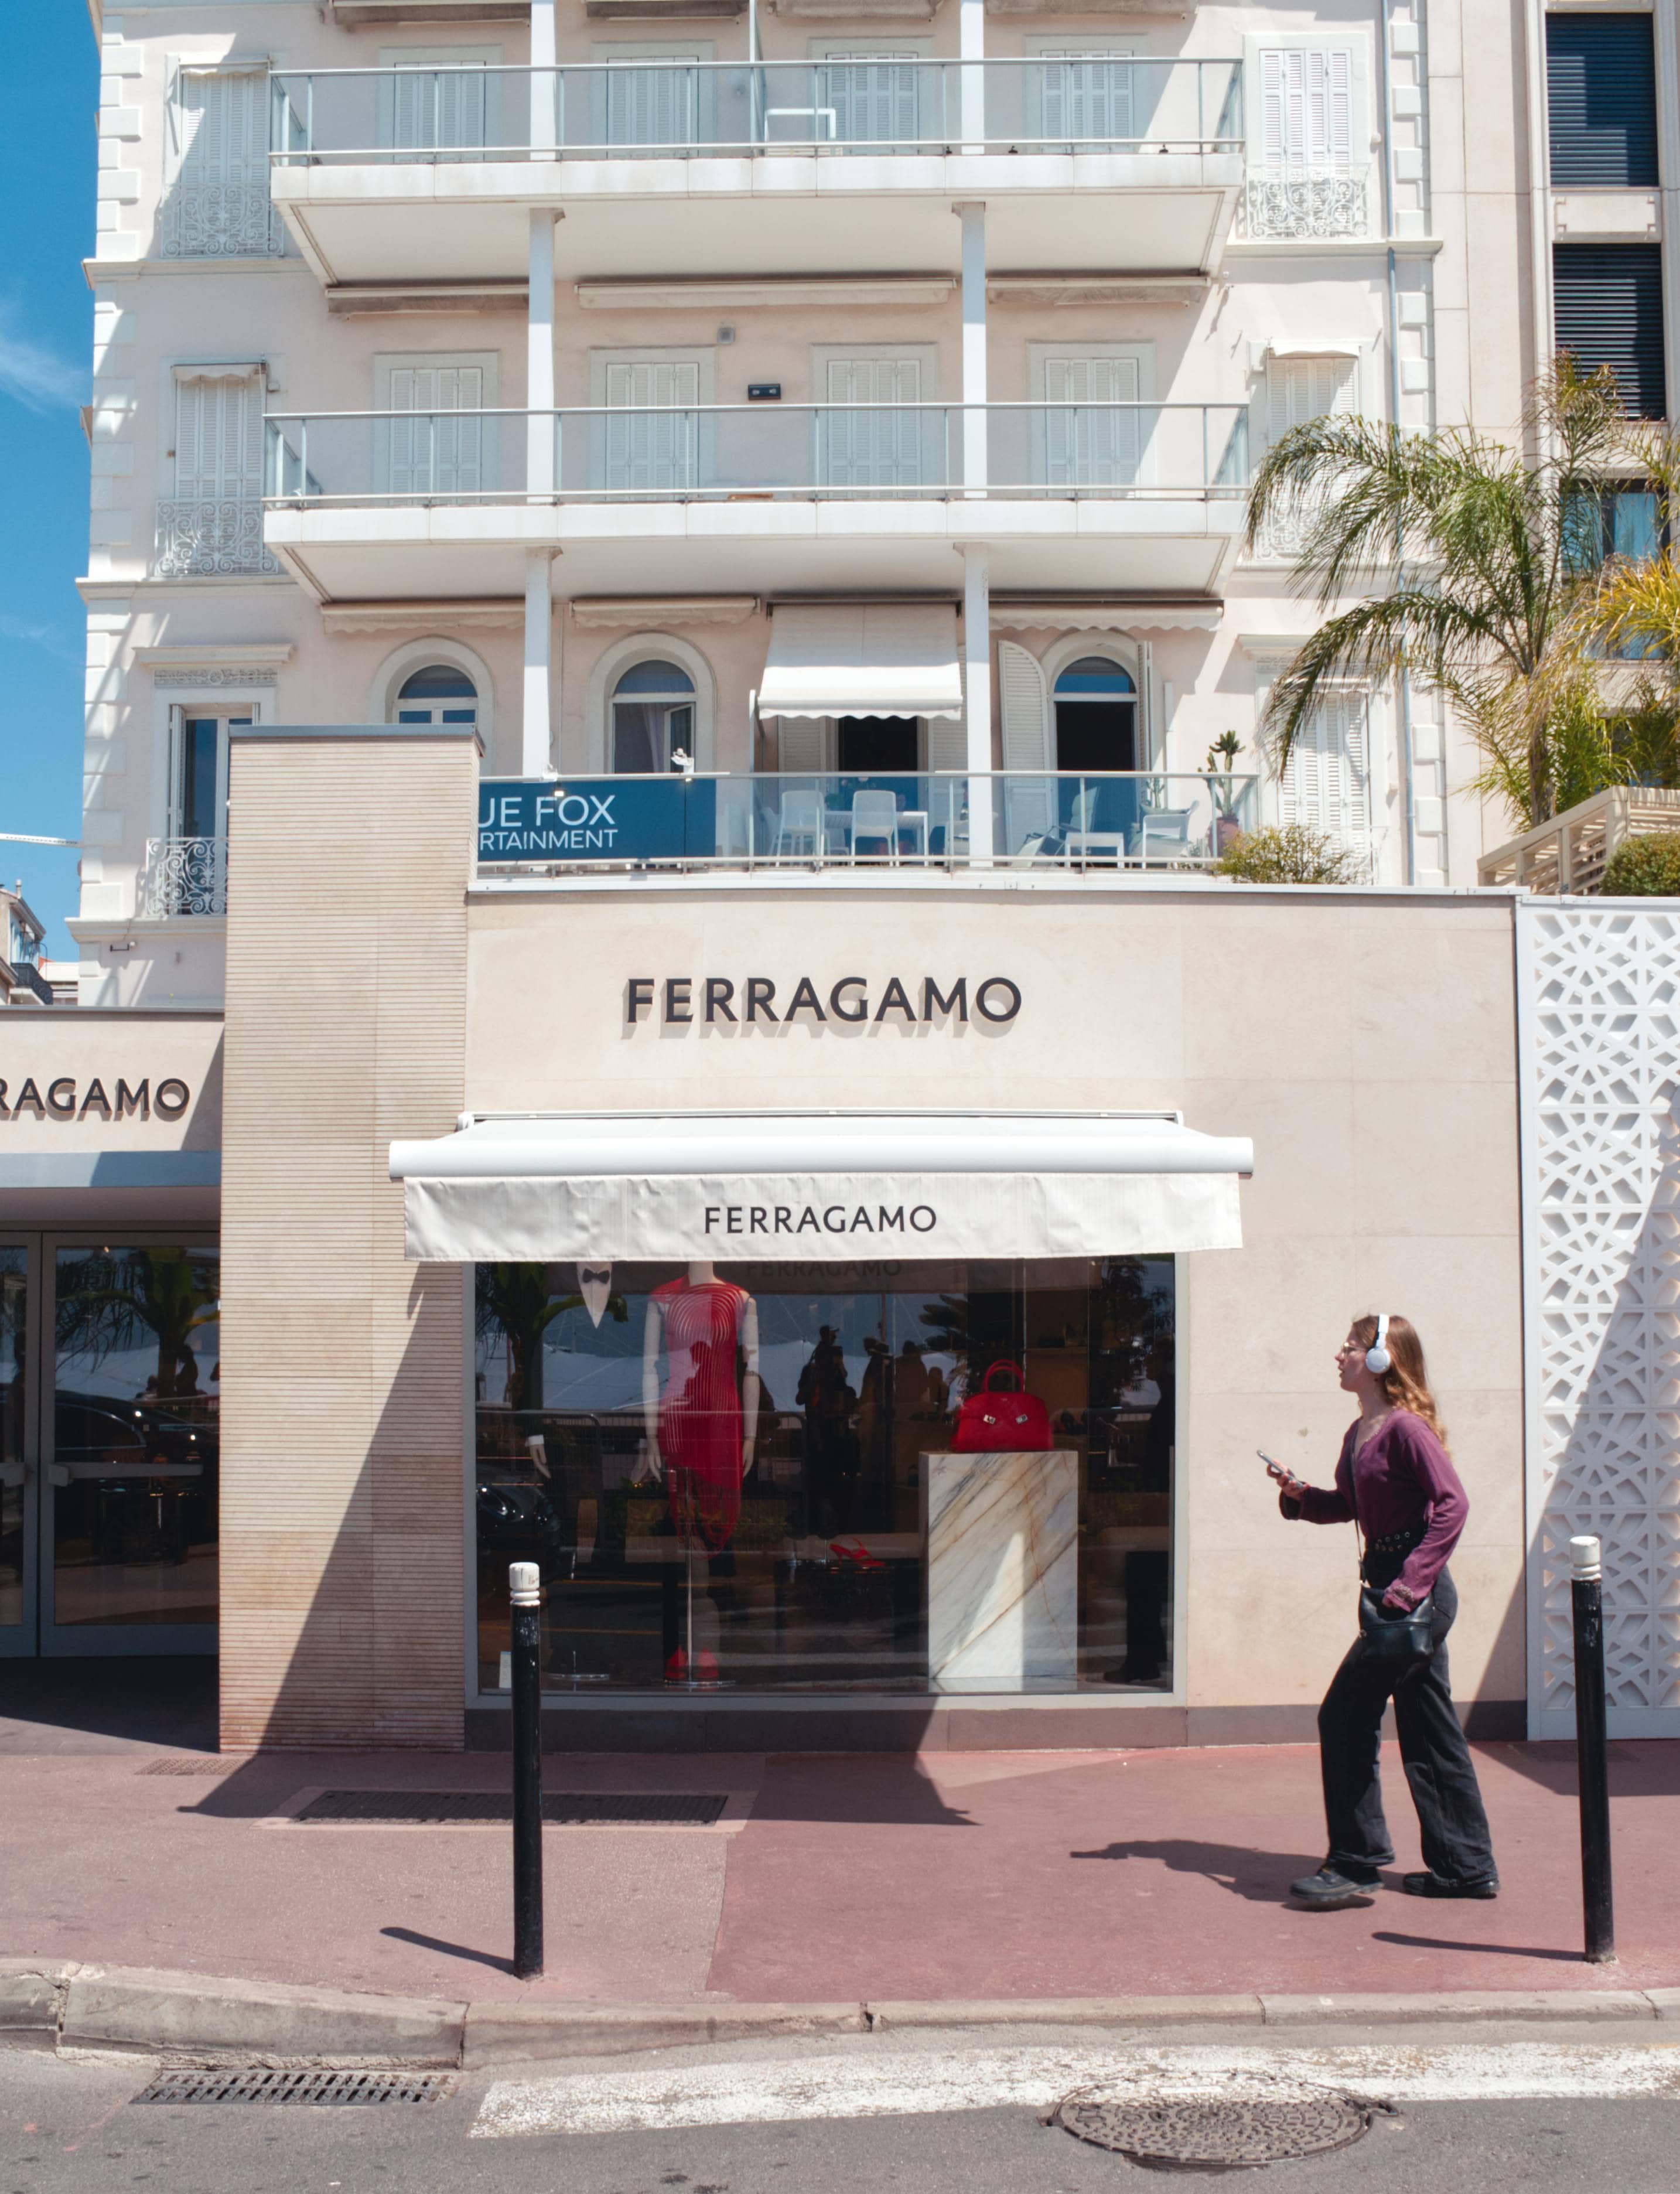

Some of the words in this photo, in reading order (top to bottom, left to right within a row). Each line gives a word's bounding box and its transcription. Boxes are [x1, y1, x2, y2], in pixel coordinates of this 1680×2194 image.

[478, 797, 522, 828] UE
[535, 794, 616, 827] FOX
[480, 829, 618, 851] RTAINMENT
[626, 976, 1022, 1023] FERRAGAMO
[704, 1205, 937, 1234] FERRAGAMO
